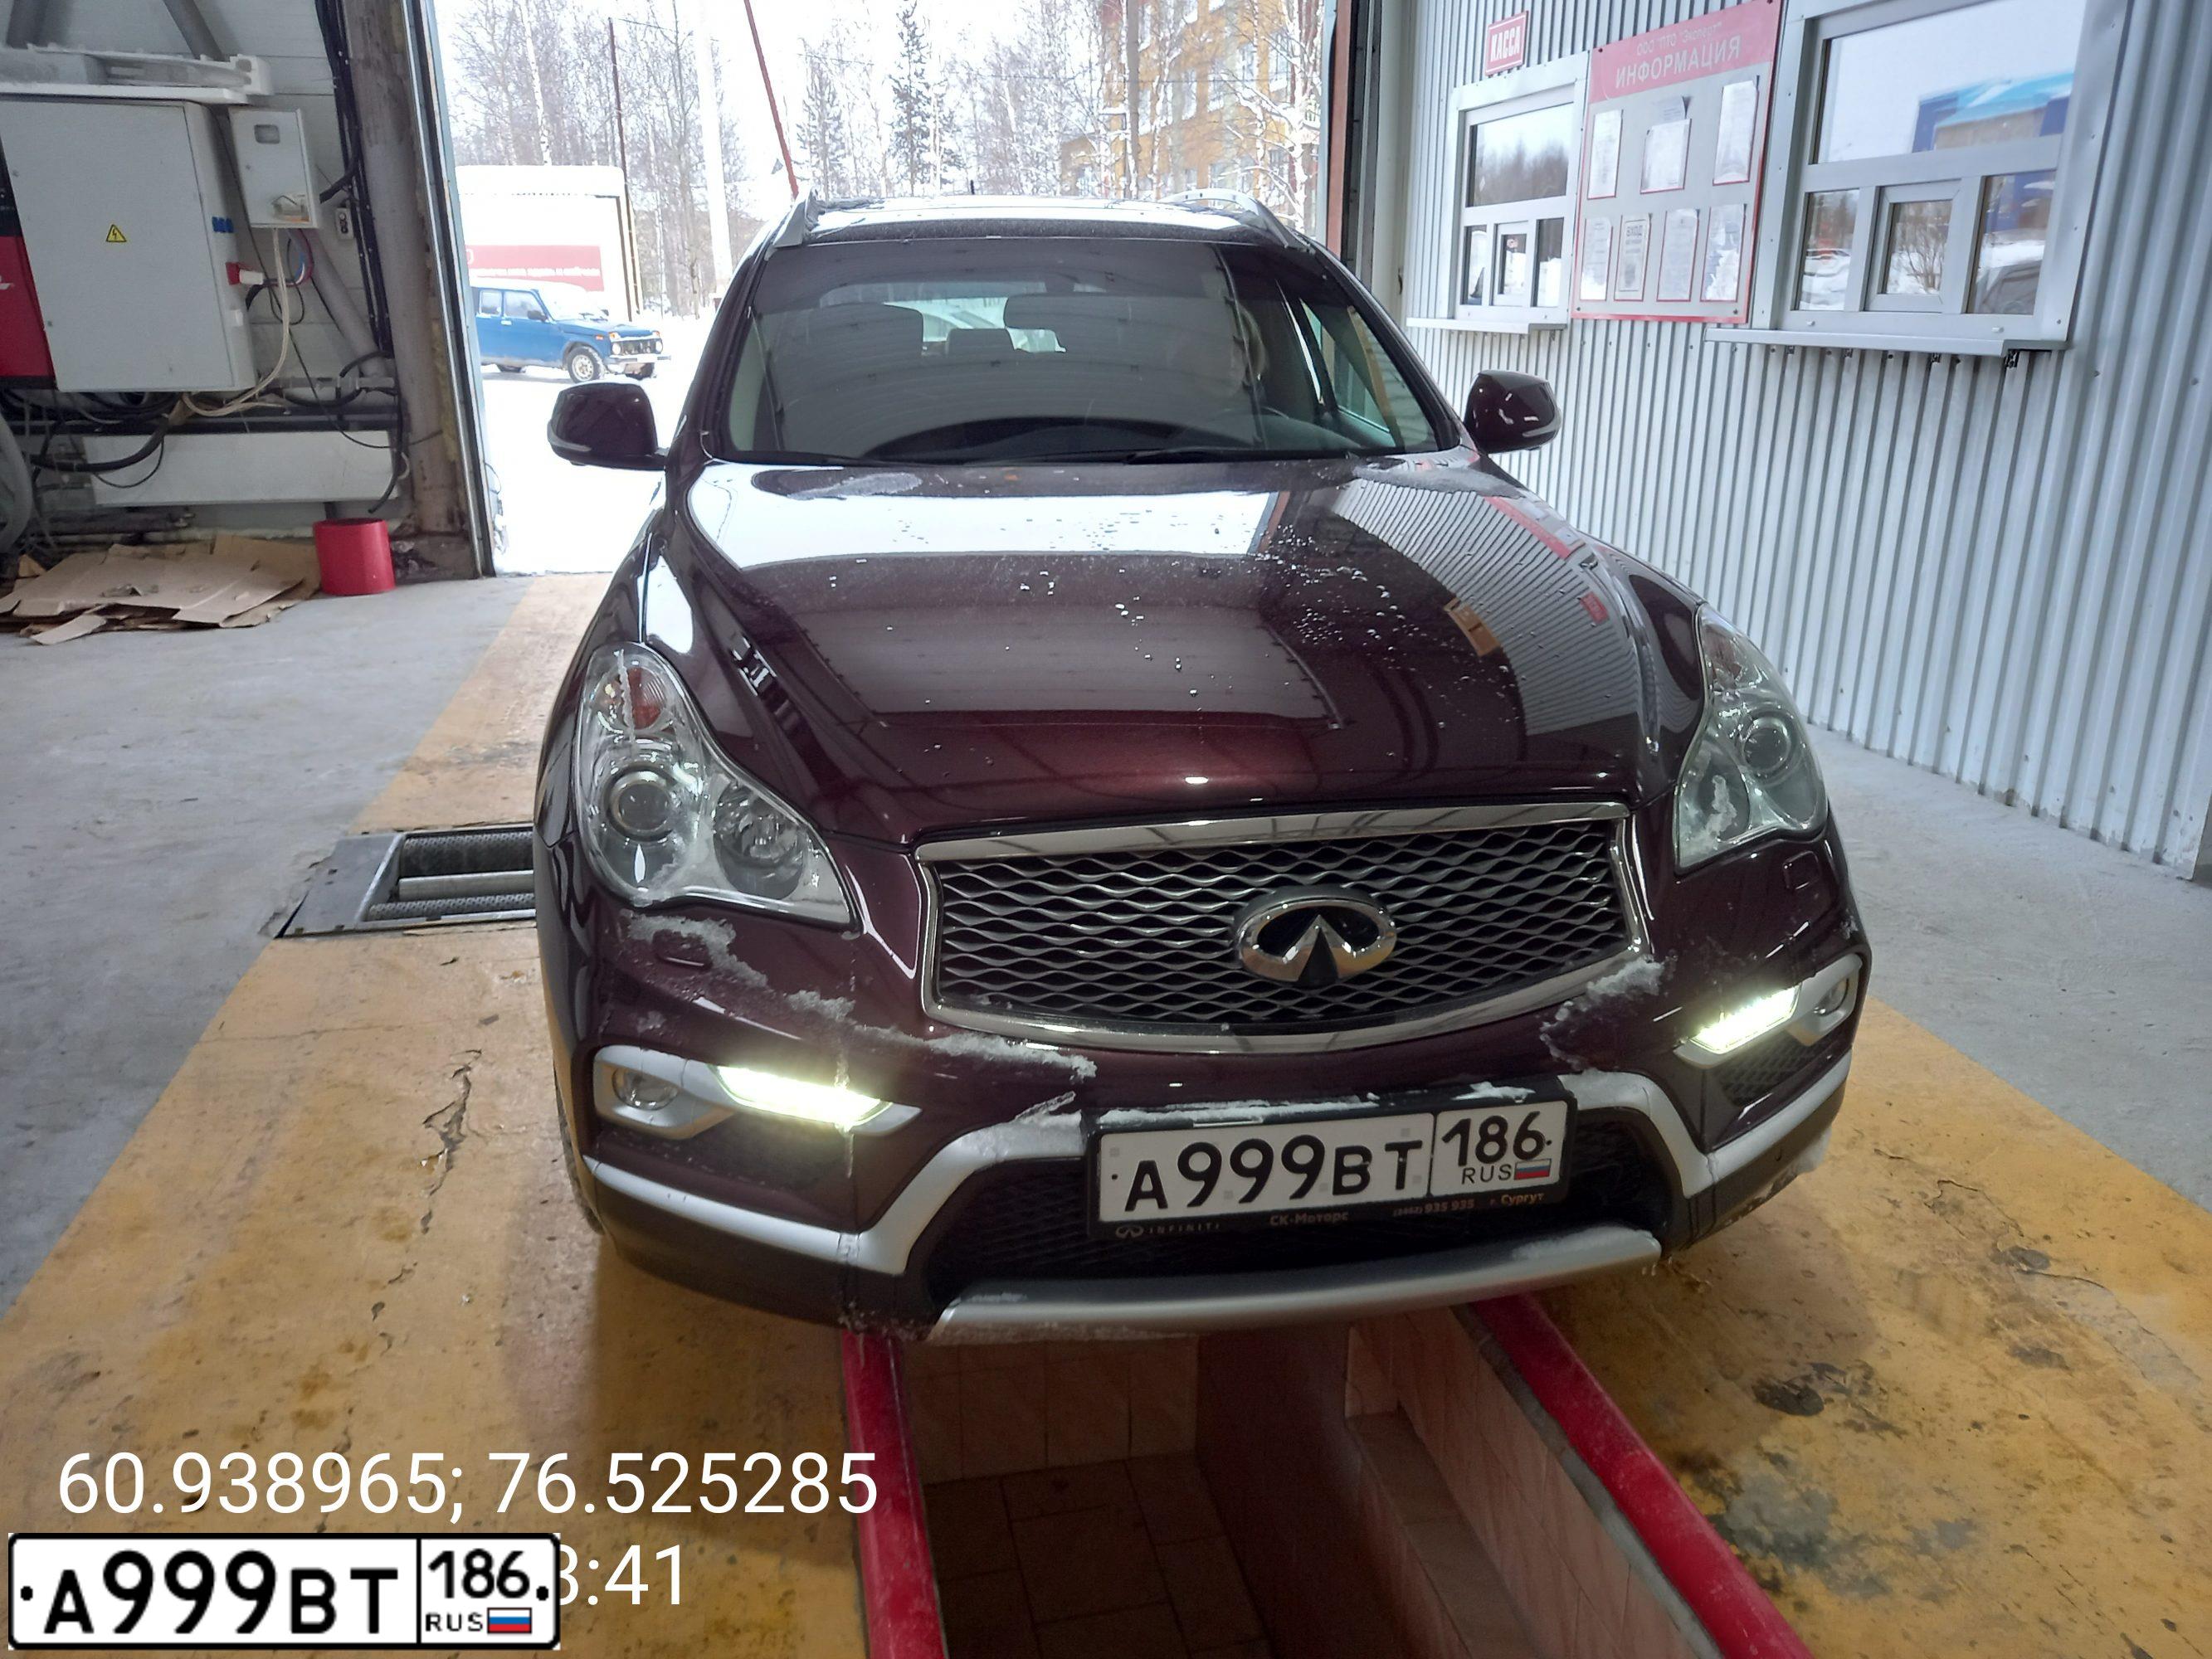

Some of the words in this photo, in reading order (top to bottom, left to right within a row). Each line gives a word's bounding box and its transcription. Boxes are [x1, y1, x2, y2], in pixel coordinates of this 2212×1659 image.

[1490, 26, 1521, 62] КАССА
[1615, 35, 1741, 89] ИНФОРМАЦИЯ
[1124, 1134, 1422, 1212] А999ВТ
[1441, 1111, 1546, 1167] 186
[1461, 1164, 1512, 1185] RUS
[1500, 1192, 1545, 1207] Сургут
[1149, 1222, 1220, 1234] INFINITI
